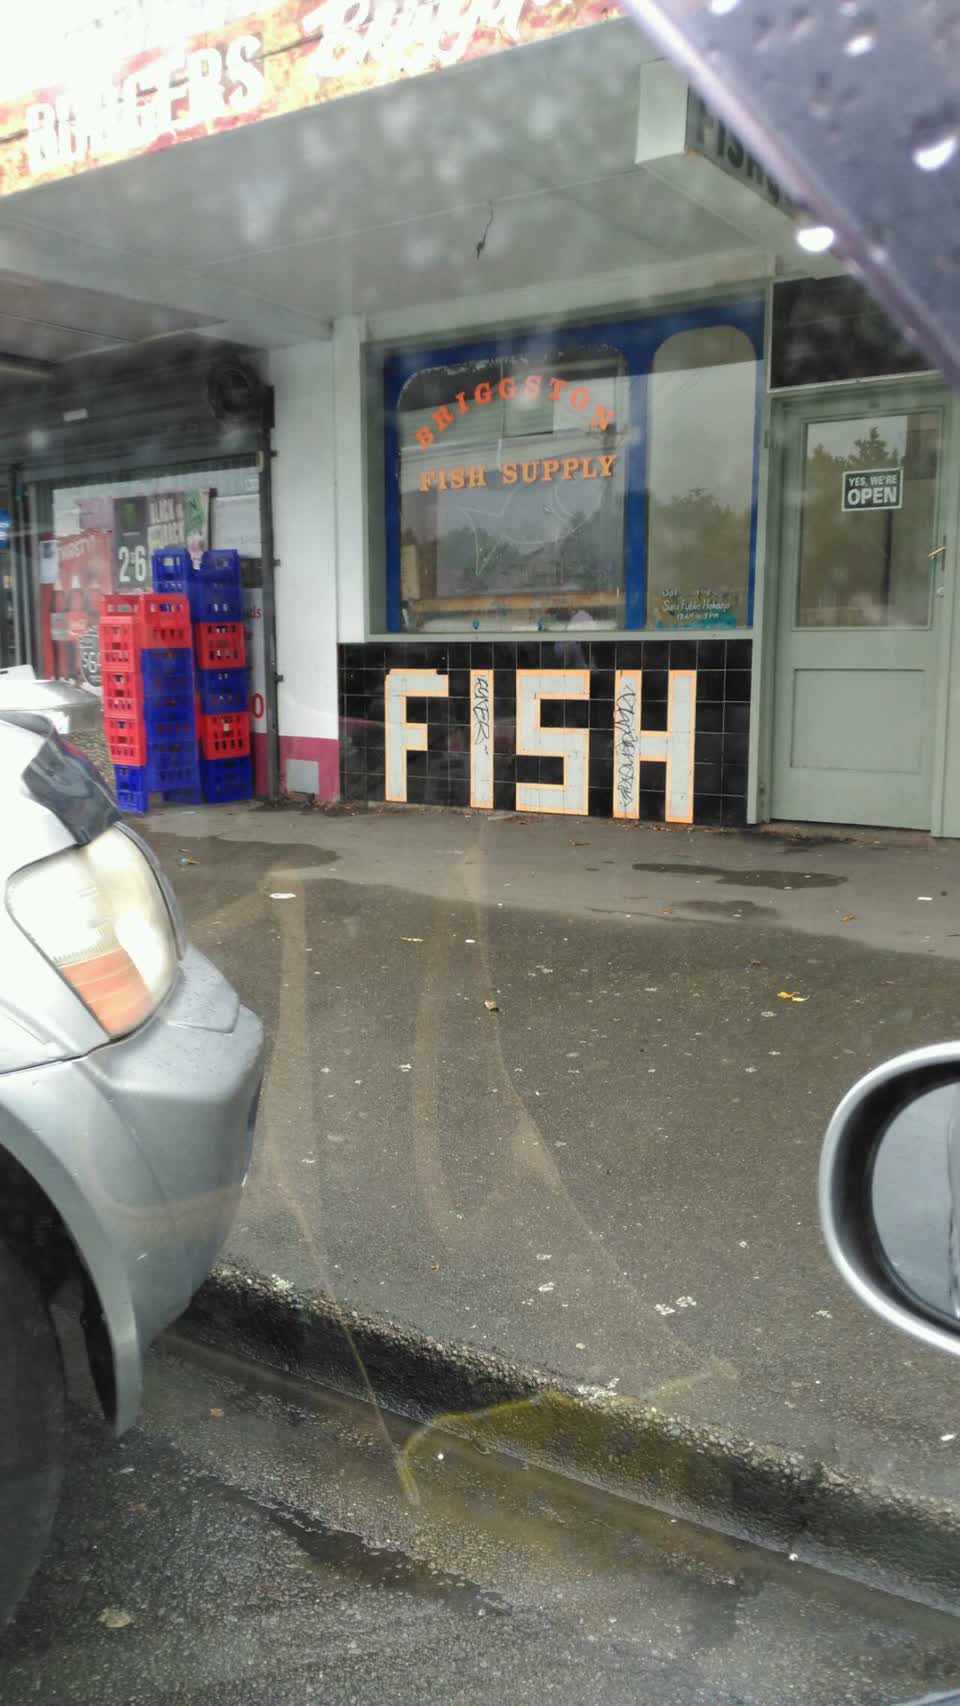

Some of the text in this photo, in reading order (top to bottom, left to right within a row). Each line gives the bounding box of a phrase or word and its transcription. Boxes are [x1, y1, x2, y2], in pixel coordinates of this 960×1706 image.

[415, 375, 615, 449] BRIGGSTON
[419, 454, 618, 492] FISH SUPPLY
[849, 476, 867, 487] YES,
[847, 486, 897, 506] OPEN
[384, 668, 698, 824] FISH
